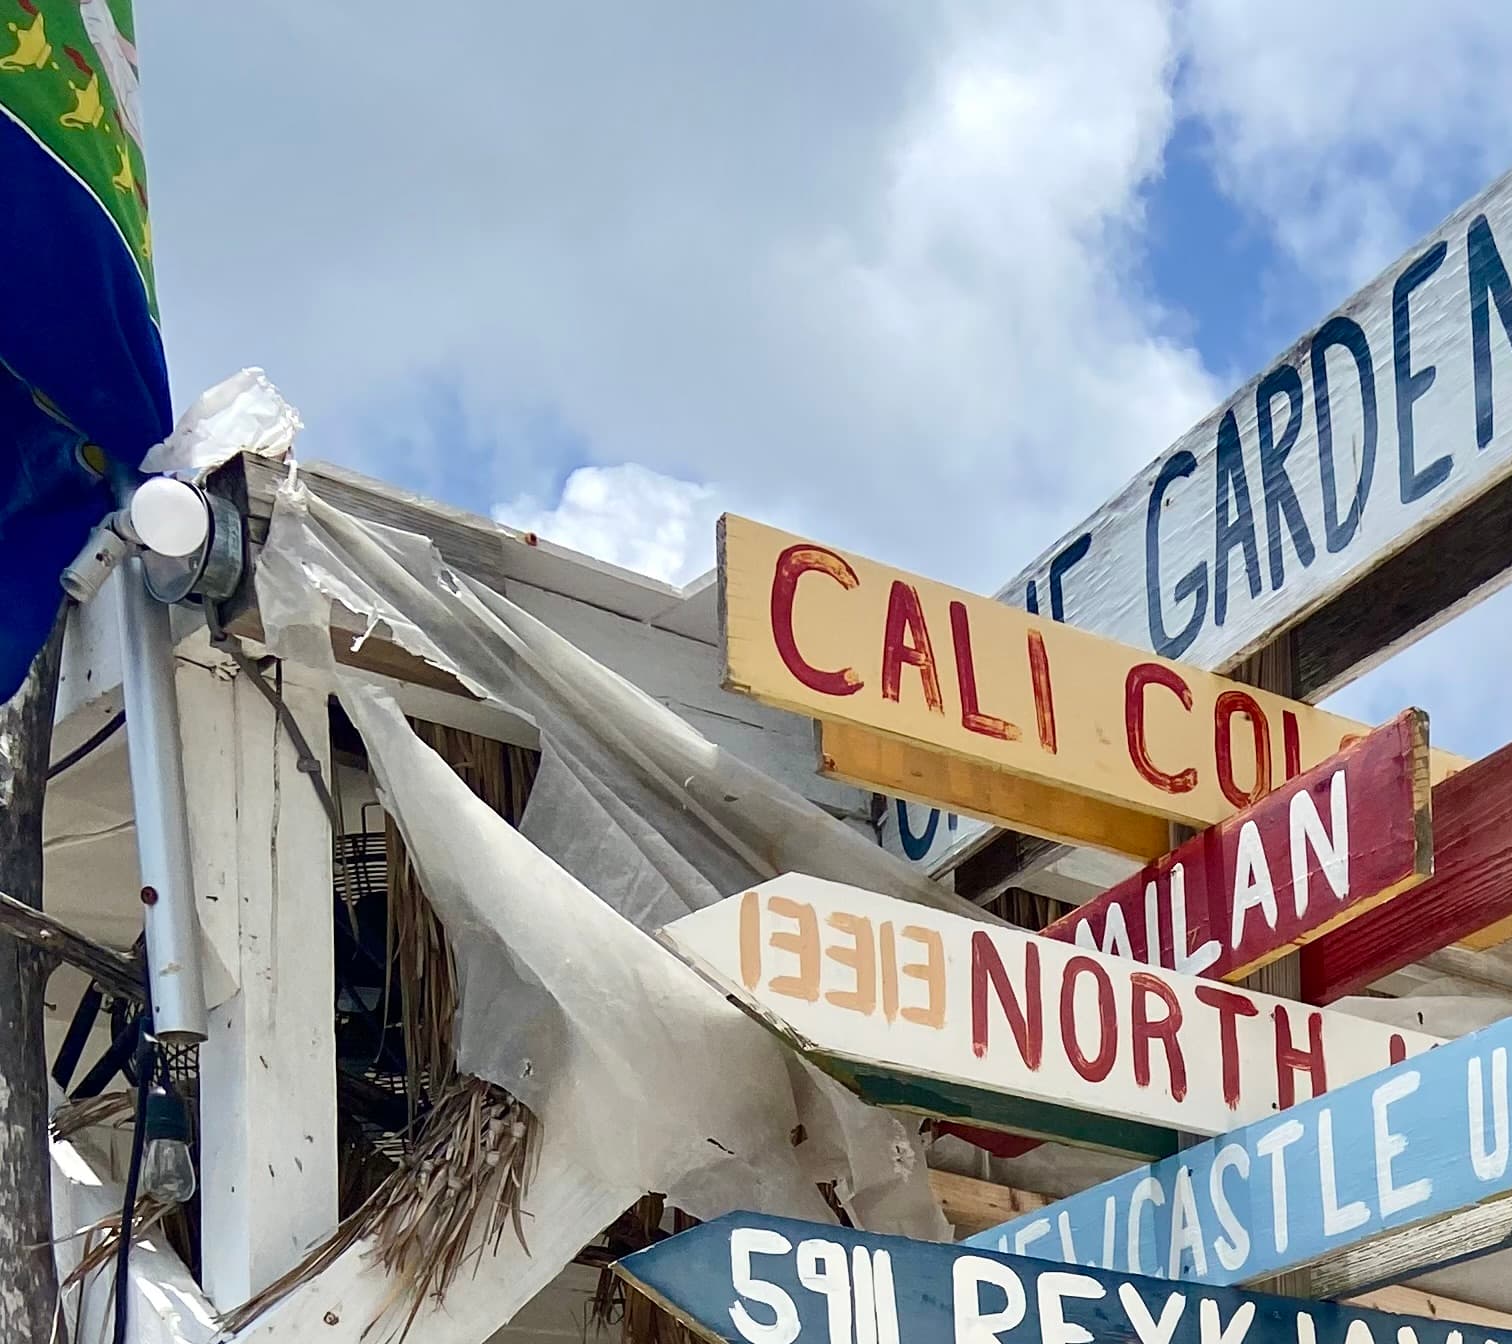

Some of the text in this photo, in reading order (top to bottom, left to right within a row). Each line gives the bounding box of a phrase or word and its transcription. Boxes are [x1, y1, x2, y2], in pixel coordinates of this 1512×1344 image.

[771, 544, 1057, 754] CALI
[1075, 770, 1350, 975] MILAN
[971, 931, 1326, 1111] NORTH
